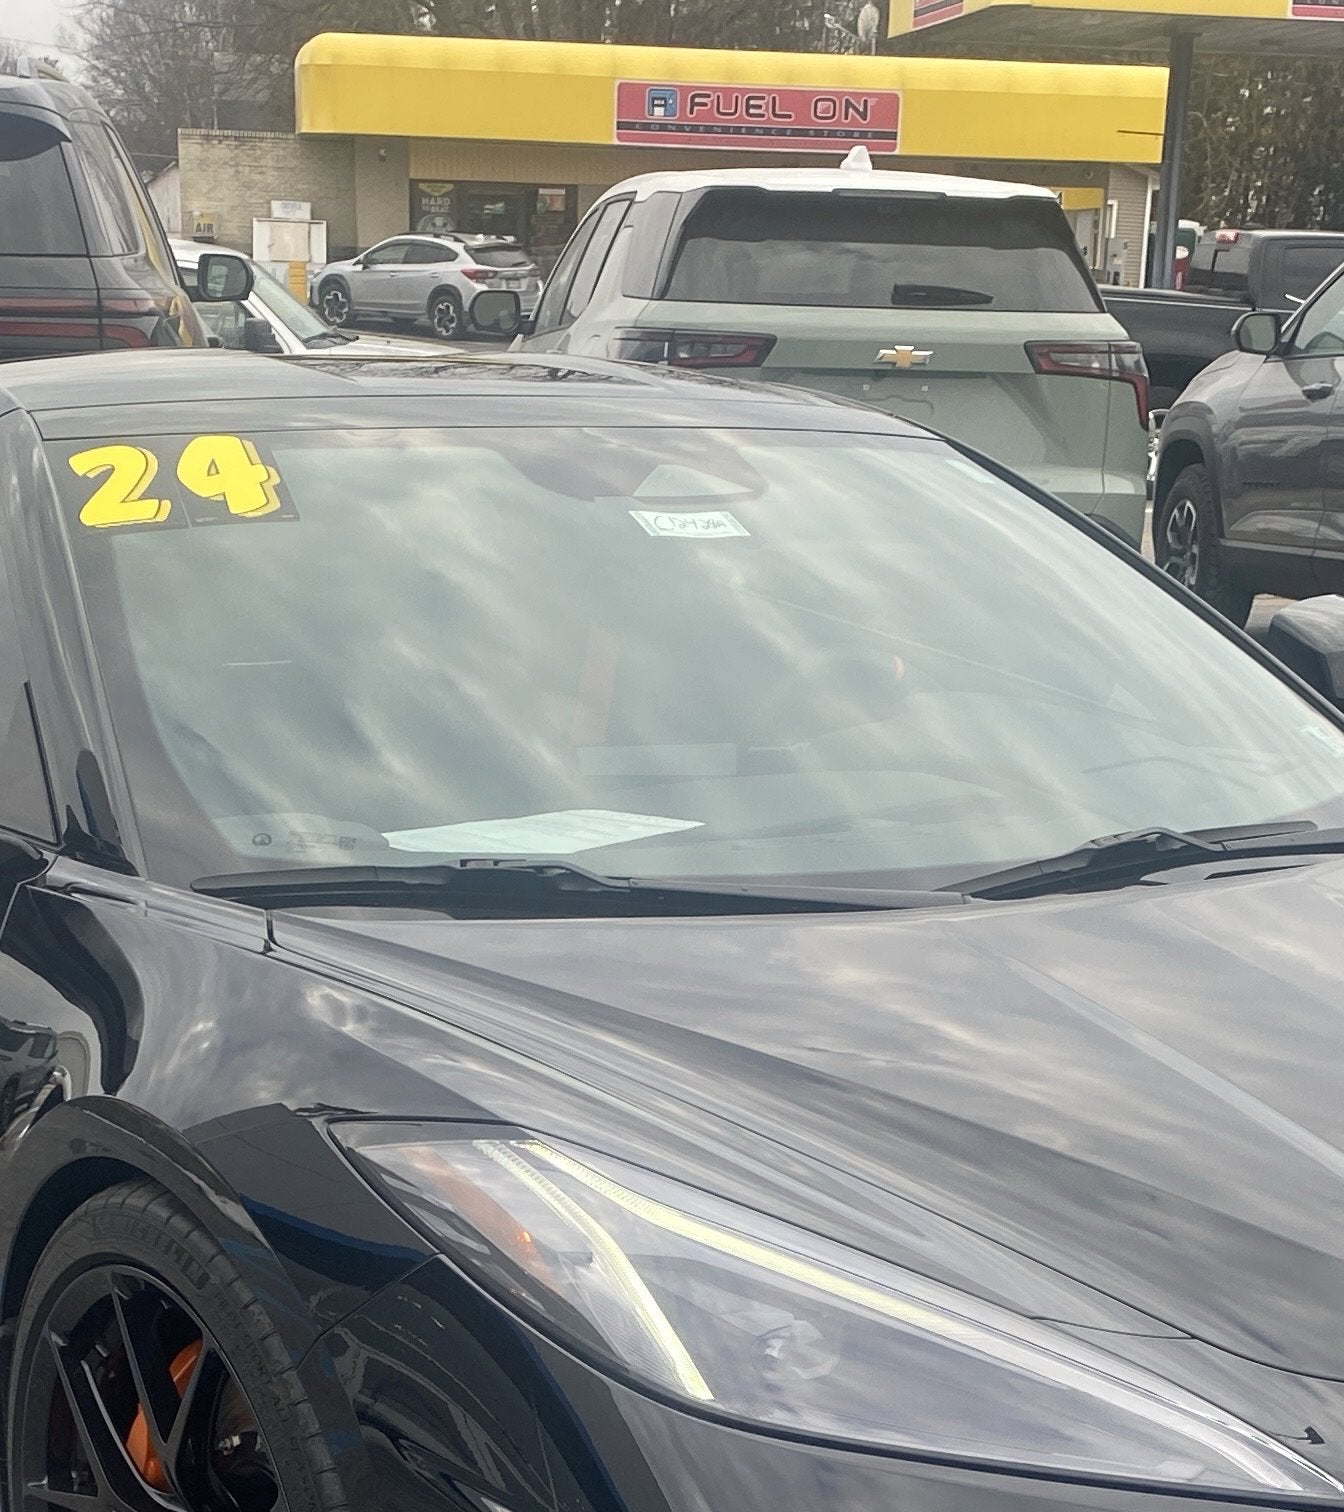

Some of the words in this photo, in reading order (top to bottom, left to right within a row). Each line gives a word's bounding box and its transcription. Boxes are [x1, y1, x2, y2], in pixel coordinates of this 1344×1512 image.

[687, 92, 794, 120] FUEL
[812, 96, 871, 122] ON
[635, 123, 794, 136] CONVENIENCE
[808, 129, 874, 139] STORE
[195, 223, 215, 234] AIR
[68, 434, 281, 528] 24
